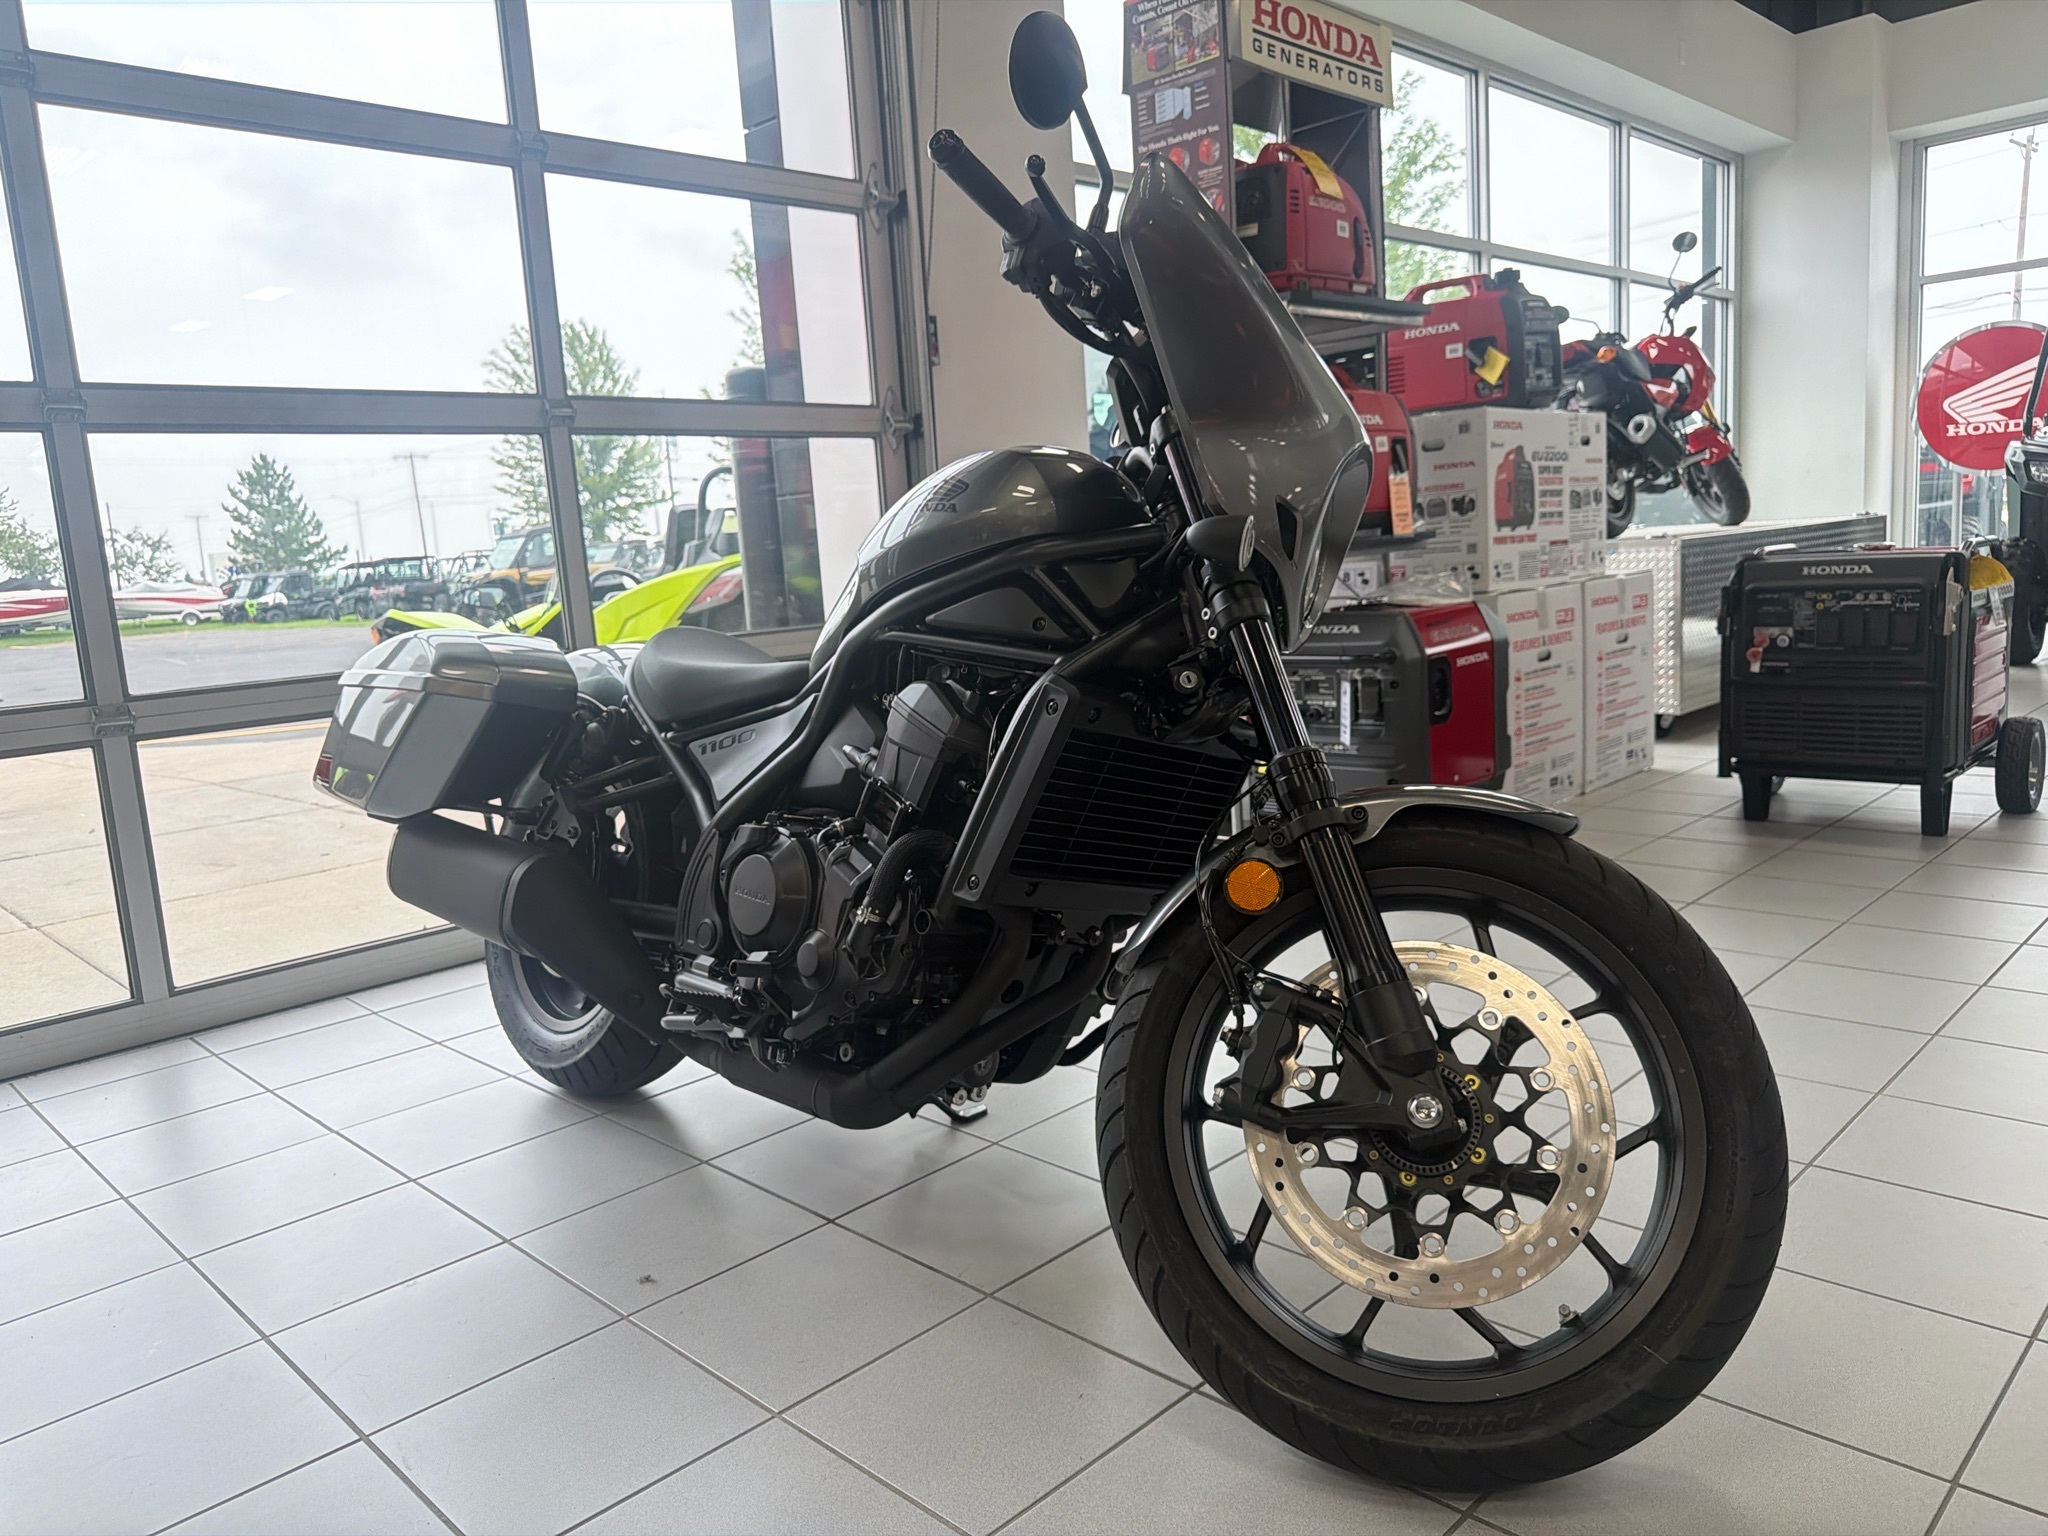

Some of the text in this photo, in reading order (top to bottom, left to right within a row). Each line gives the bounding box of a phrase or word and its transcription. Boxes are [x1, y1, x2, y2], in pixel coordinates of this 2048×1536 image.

[1252, 0, 1382, 69] HONDA
[1252, 37, 1384, 93] GENERATORS
[1404, 322, 1461, 340] HONDA
[1493, 419, 1523, 431] HONDA
[1946, 416, 2044, 437] HONDA
[1433, 460, 1476, 472] HONDA
[1802, 564, 1873, 576] HONDA
[1591, 595, 1619, 607] HONDA
[1506, 610, 1539, 623] HONDA
[1313, 624, 1361, 634] NDA
[1456, 652, 1489, 668] HONDA
[698, 728, 757, 756] 1100
[735, 886, 770, 906] HONDA
